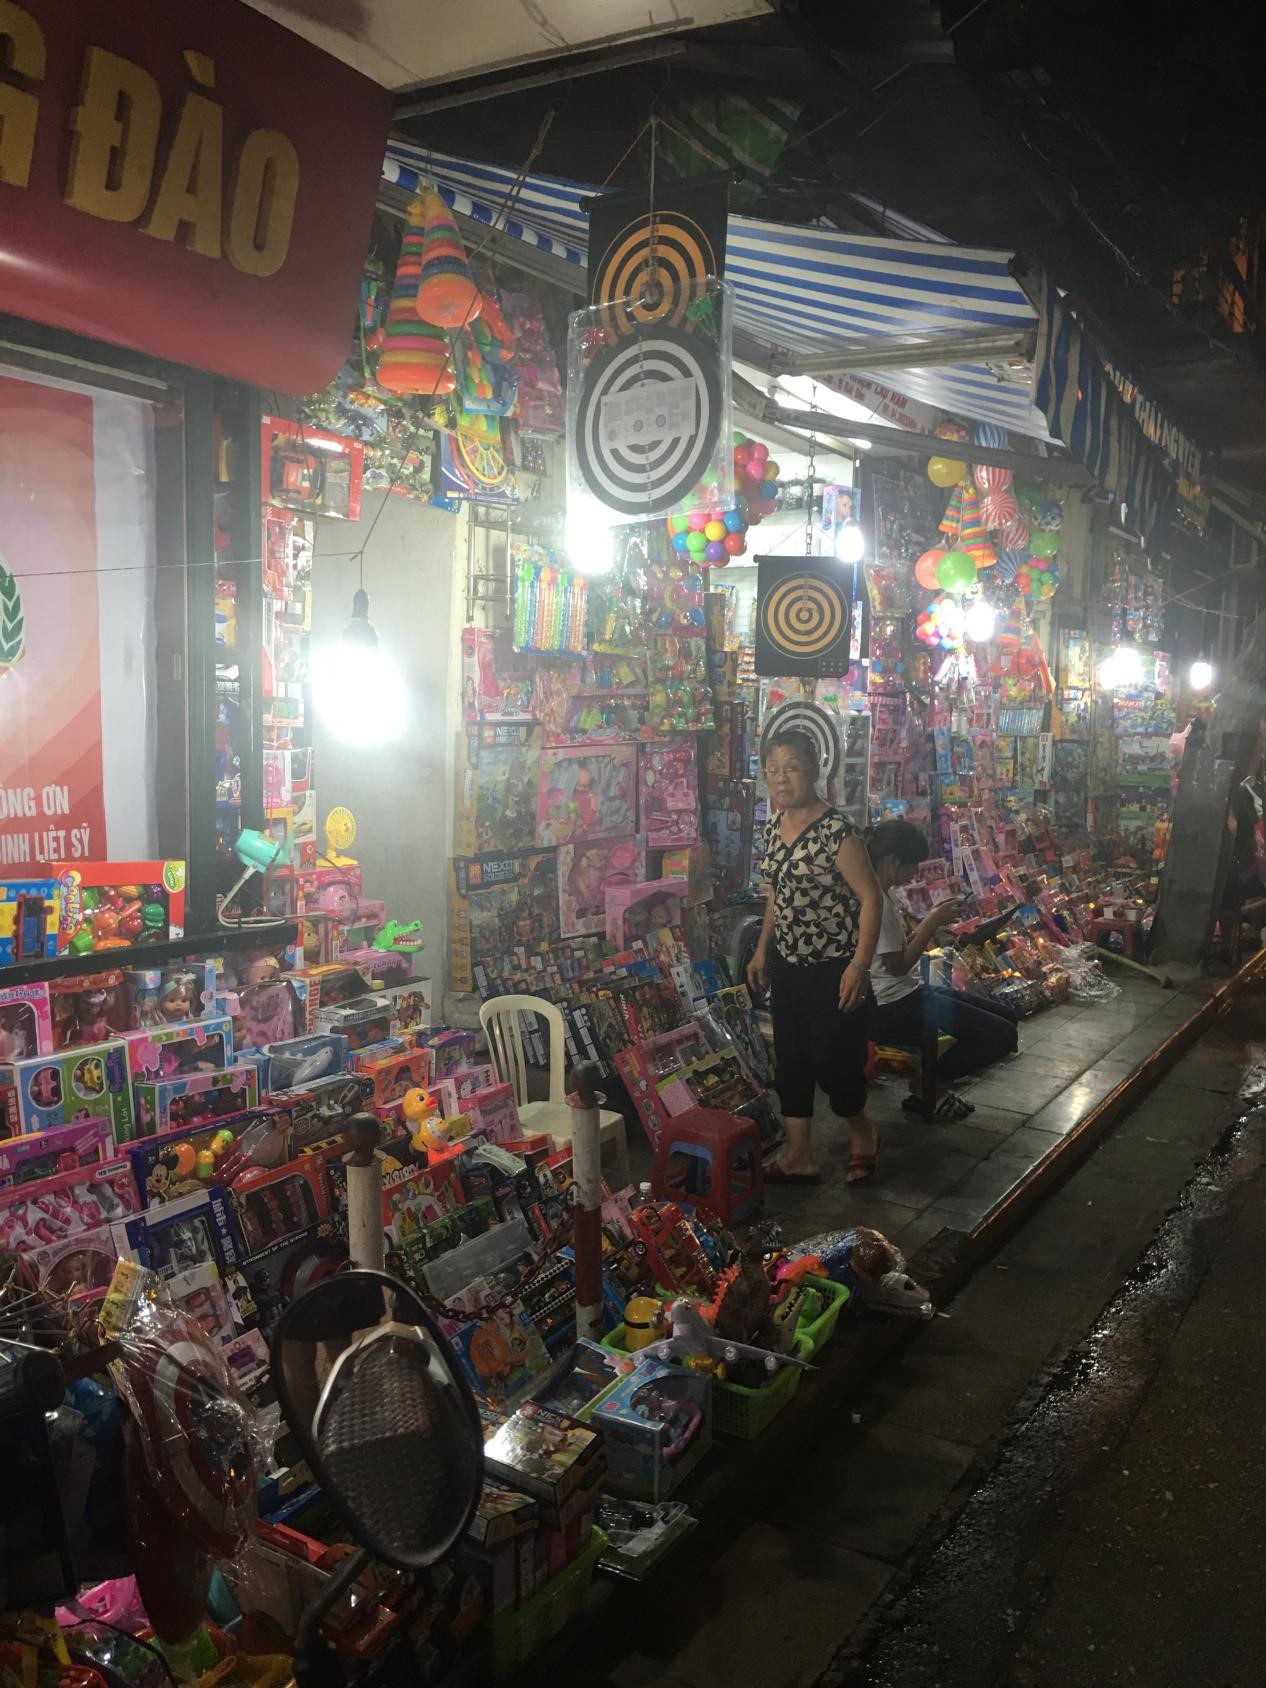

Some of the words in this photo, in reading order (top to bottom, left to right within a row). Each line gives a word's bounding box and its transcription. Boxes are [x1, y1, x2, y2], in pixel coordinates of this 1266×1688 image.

[63, 45, 299, 277] ĐÀO
[42, 784, 70, 816] ƠN
[71, 822, 91, 859] SỸ
